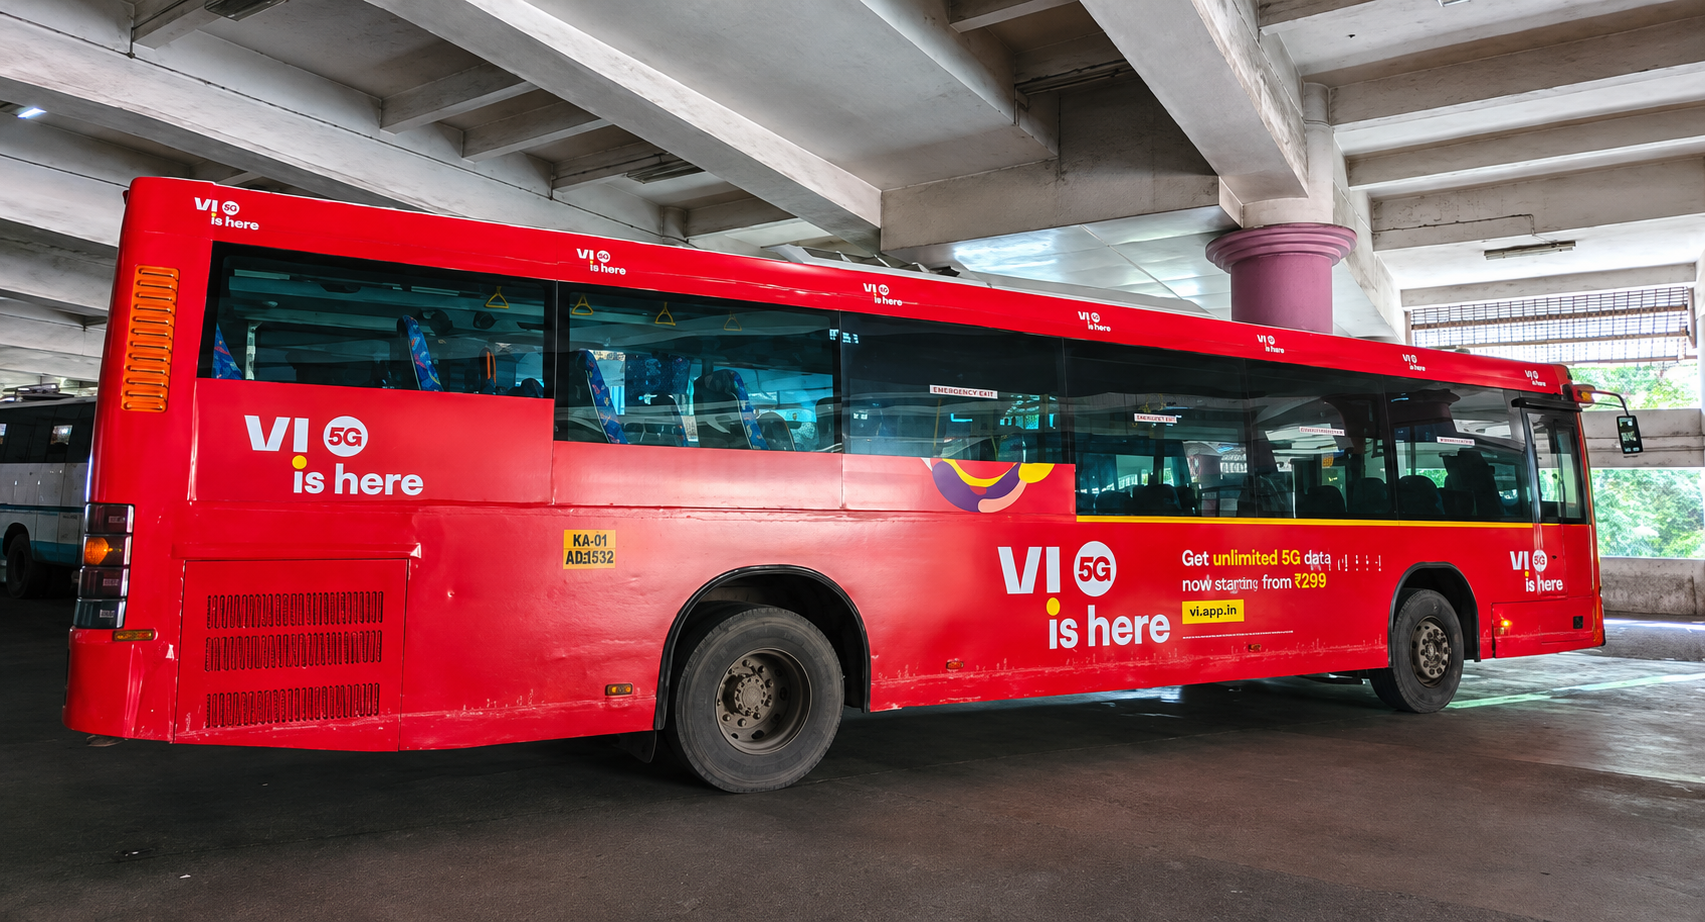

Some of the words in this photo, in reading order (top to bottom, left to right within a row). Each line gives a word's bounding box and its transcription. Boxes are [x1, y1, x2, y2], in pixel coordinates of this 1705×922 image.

[211, 212, 223, 226] is
[225, 216, 259, 230] here
[600, 263, 626, 275] here
[244, 415, 309, 453] VI
[328, 427, 362, 447] 5G
[292, 455, 325, 494] is
[334, 463, 424, 496] here
[573, 534, 607, 547] KA-01
[1182, 550, 1209, 566] Get
[1213, 549, 1278, 566] unlimited
[1282, 549, 1301, 565] 5G
[1304, 550, 1331, 565] data
[998, 546, 1061, 594] VI
[1078, 556, 1111, 582] 5G
[1182, 579, 1212, 592] now
[1215, 577, 1258, 593] starting
[1262, 574, 1292, 590] from
[1294, 573, 1327, 589] ₹299
[1525, 571, 1535, 592] is
[1537, 574, 1563, 592] here
[1189, 604, 1237, 618] vi.app.in
[1046, 597, 1079, 650] is
[1088, 604, 1171, 647] here
